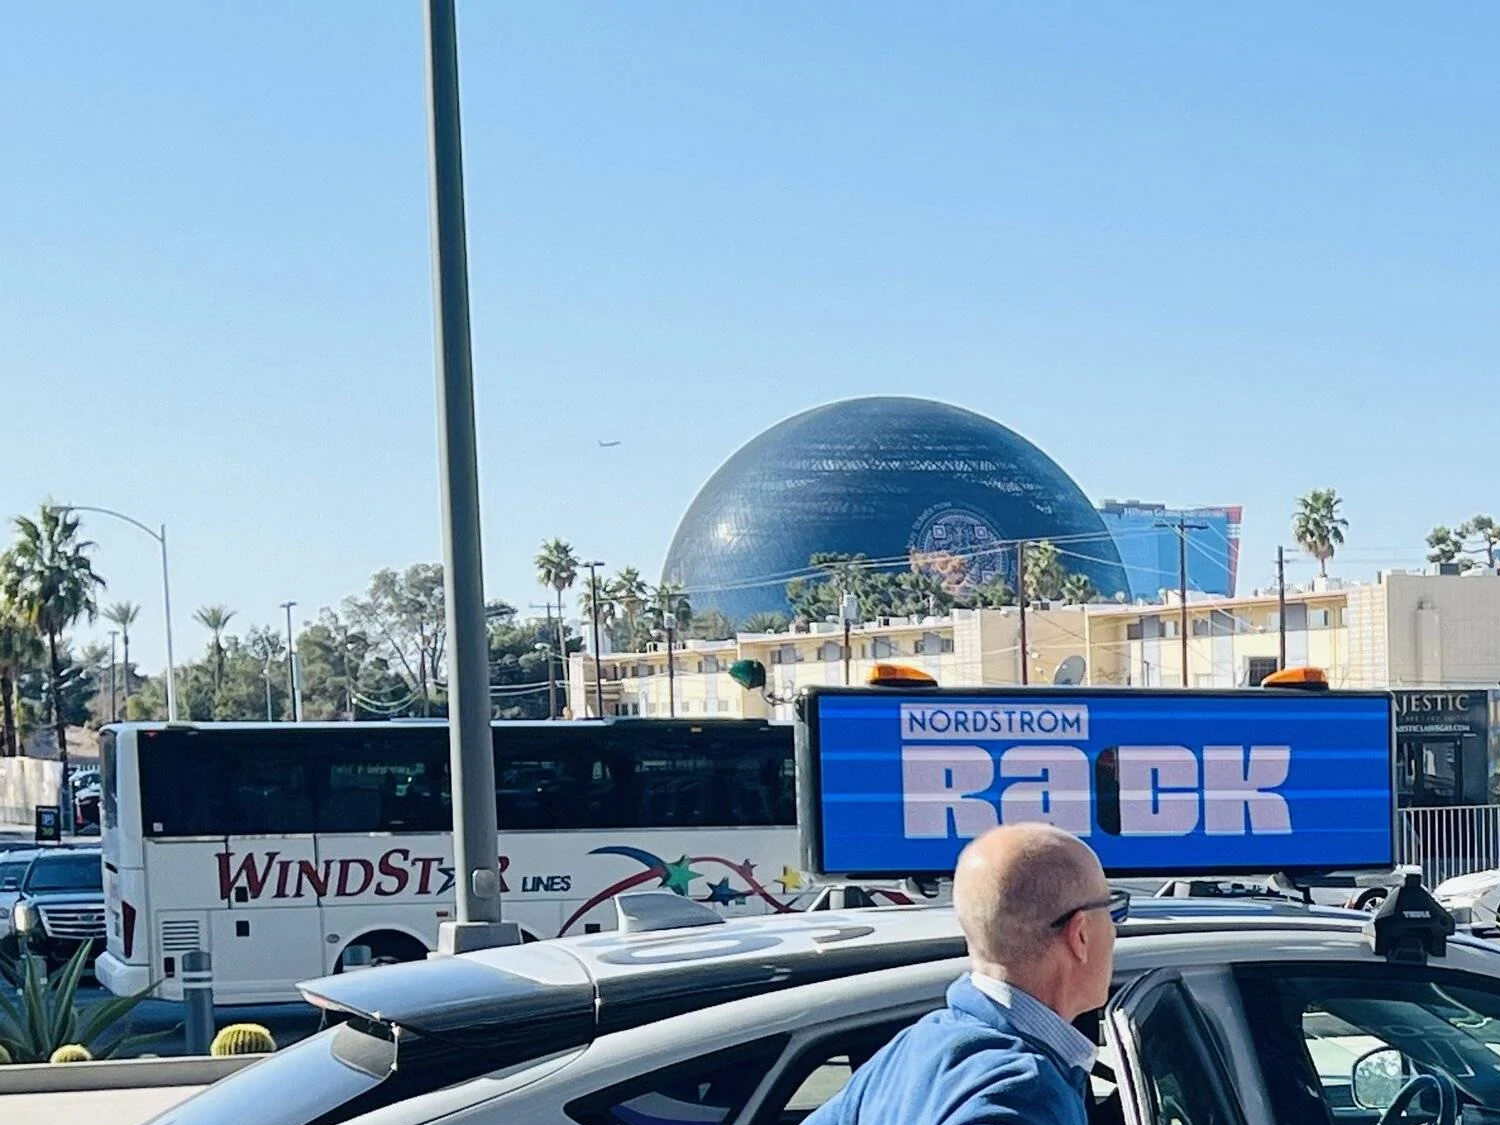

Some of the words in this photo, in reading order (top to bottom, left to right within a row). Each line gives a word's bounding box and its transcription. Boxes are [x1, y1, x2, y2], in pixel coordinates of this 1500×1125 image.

[1396, 694, 1469, 716] JESTIC
[908, 709, 1082, 734] NORDSTROM
[214, 848, 511, 900] WINDST
[521, 875, 571, 892] LINES
